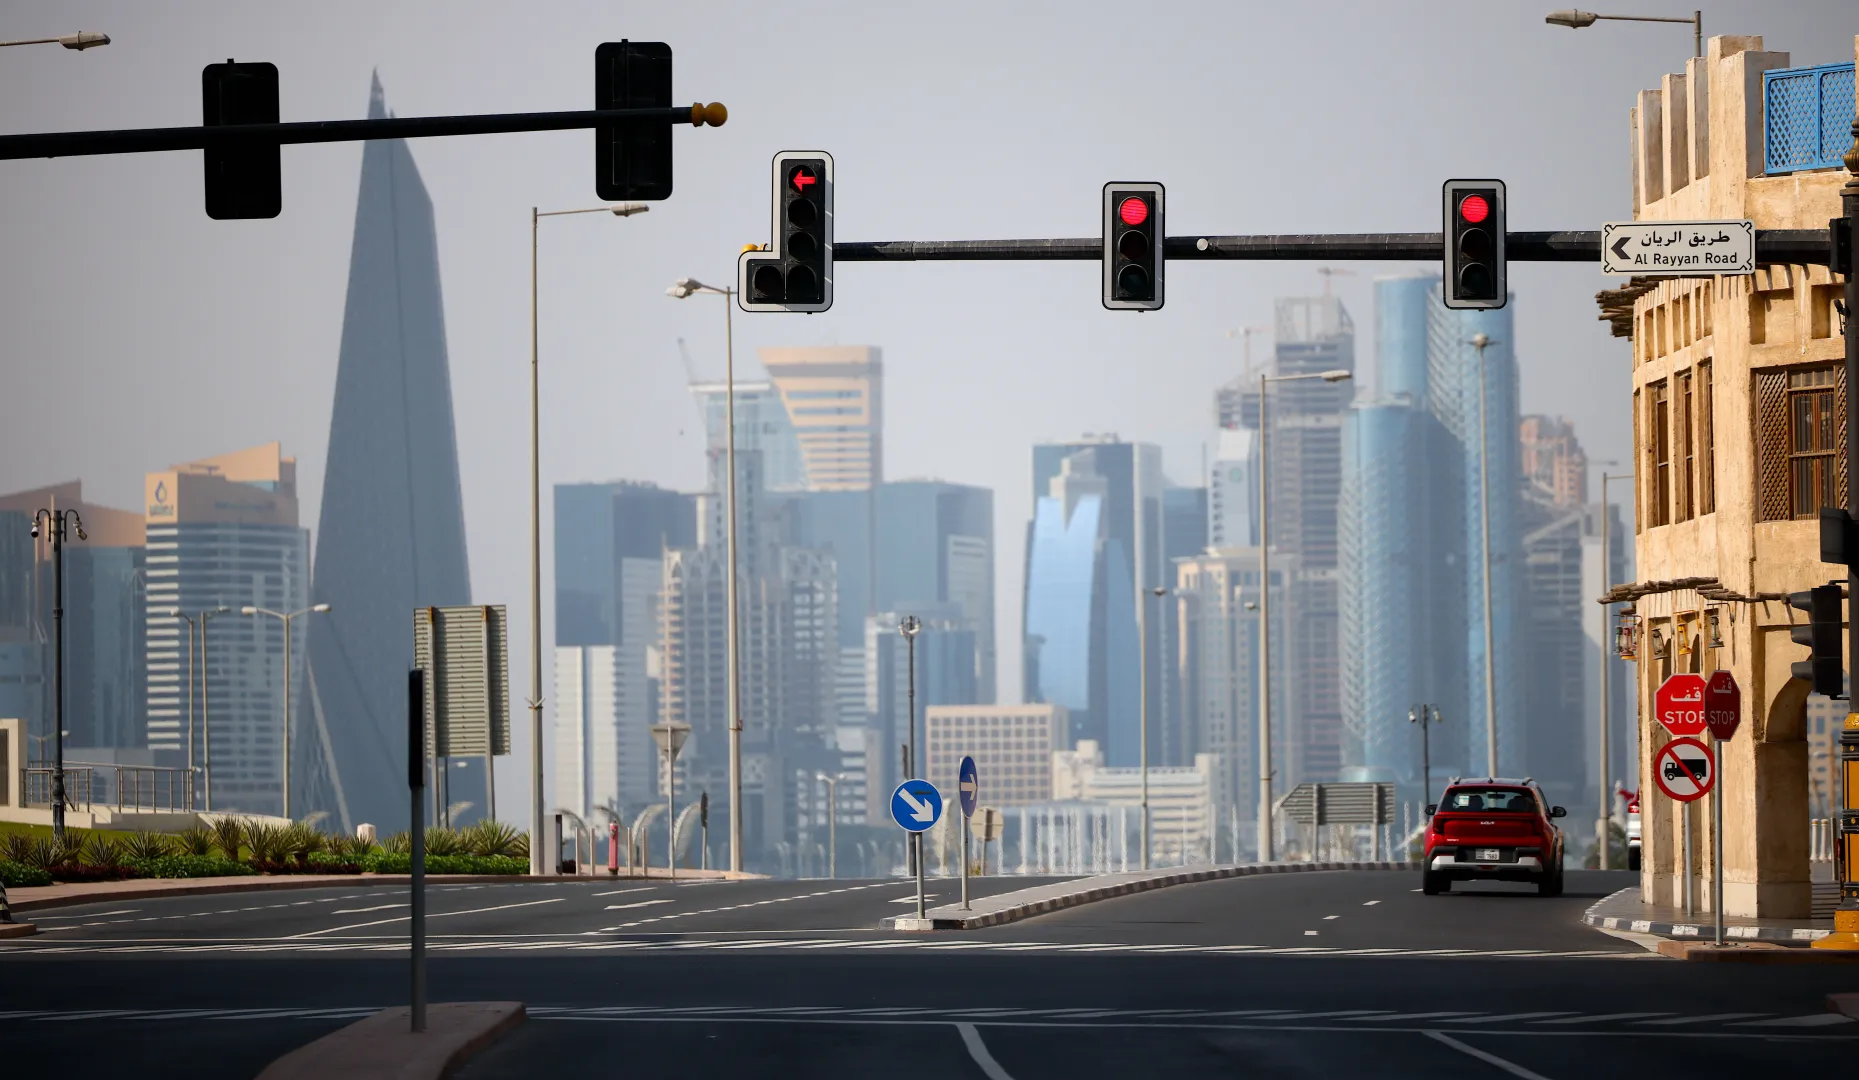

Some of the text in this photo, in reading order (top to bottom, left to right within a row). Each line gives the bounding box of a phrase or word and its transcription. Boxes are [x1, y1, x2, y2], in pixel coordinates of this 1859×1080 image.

[1640, 230, 1731, 248] طريق الريان
[1634, 252, 1738, 267] Al Rayyan Road
[1712, 677, 1732, 694] قف
[1670, 686, 1702, 702] قف
[1710, 710, 1735, 725] STOP
